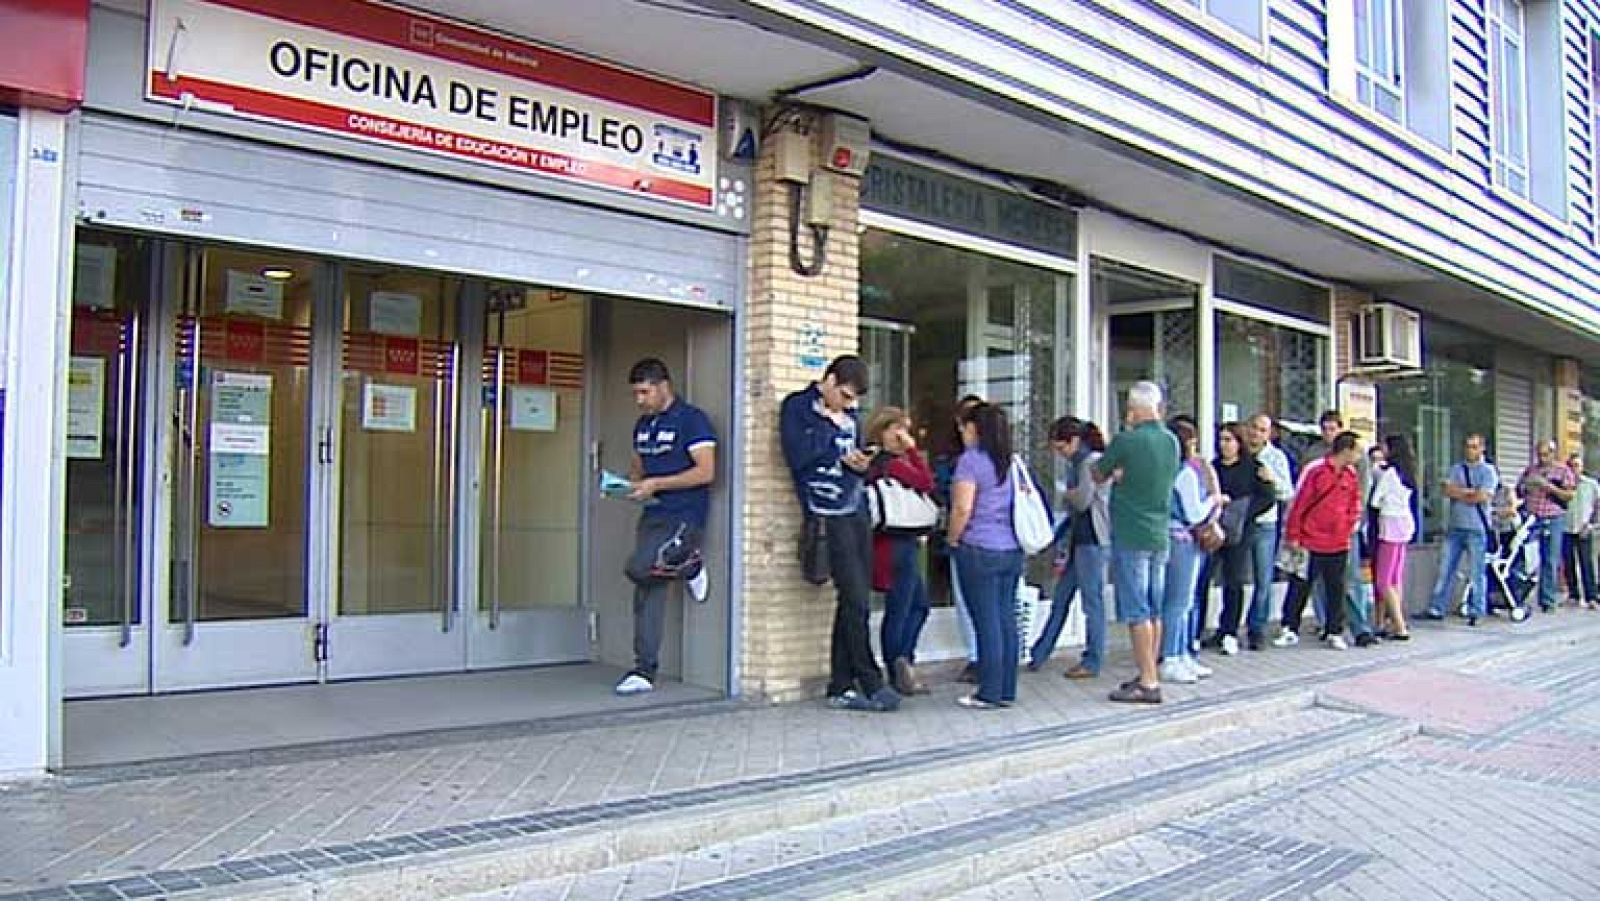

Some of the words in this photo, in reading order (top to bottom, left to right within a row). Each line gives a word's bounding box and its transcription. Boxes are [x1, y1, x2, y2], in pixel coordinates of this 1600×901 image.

[270, 41, 437, 109] OFICINA
[449, 81, 498, 122] DE
[508, 95, 644, 153] EMPLEO
[435, 132, 453, 149] DE
[530, 151, 540, 165] Y
